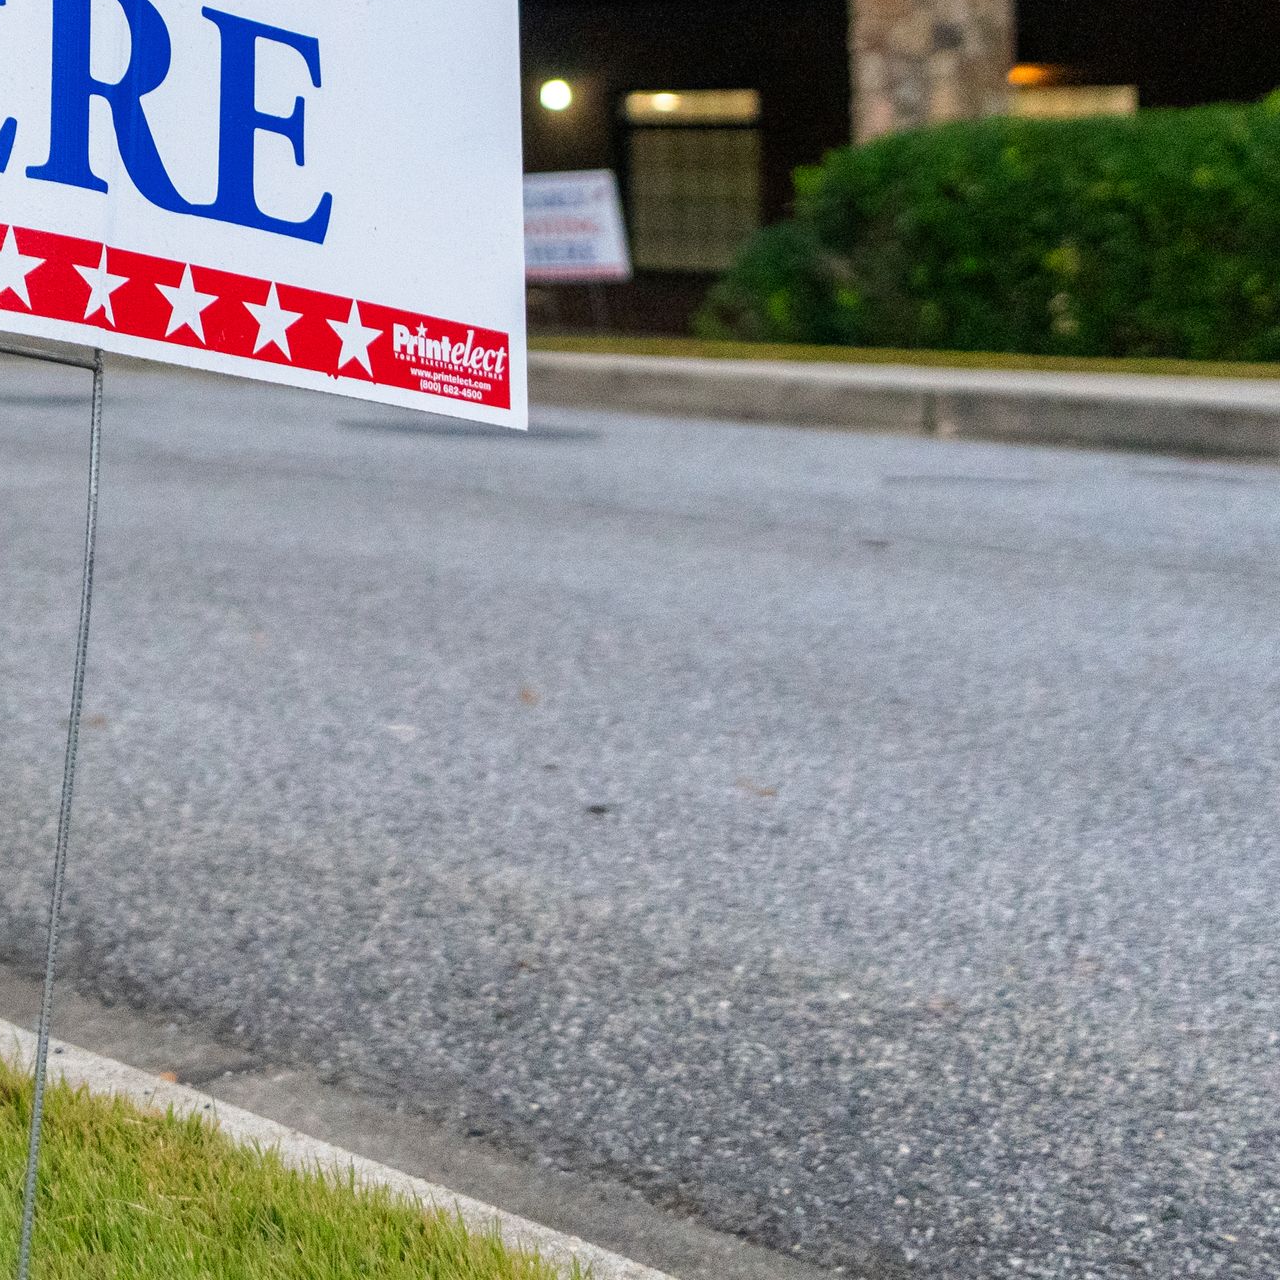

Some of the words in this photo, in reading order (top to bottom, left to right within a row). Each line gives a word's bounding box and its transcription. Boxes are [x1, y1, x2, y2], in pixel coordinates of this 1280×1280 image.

[392, 321, 507, 374] Printelect
[394, 350, 417, 363] YOUR
[420, 357, 464, 373] ELECTIONS
[467, 366, 503, 381] PARTNER
[410, 366, 492, 392] www.printelect.com
[419, 378, 441, 393] (800)
[442, 383, 483, 400] 682-4500
